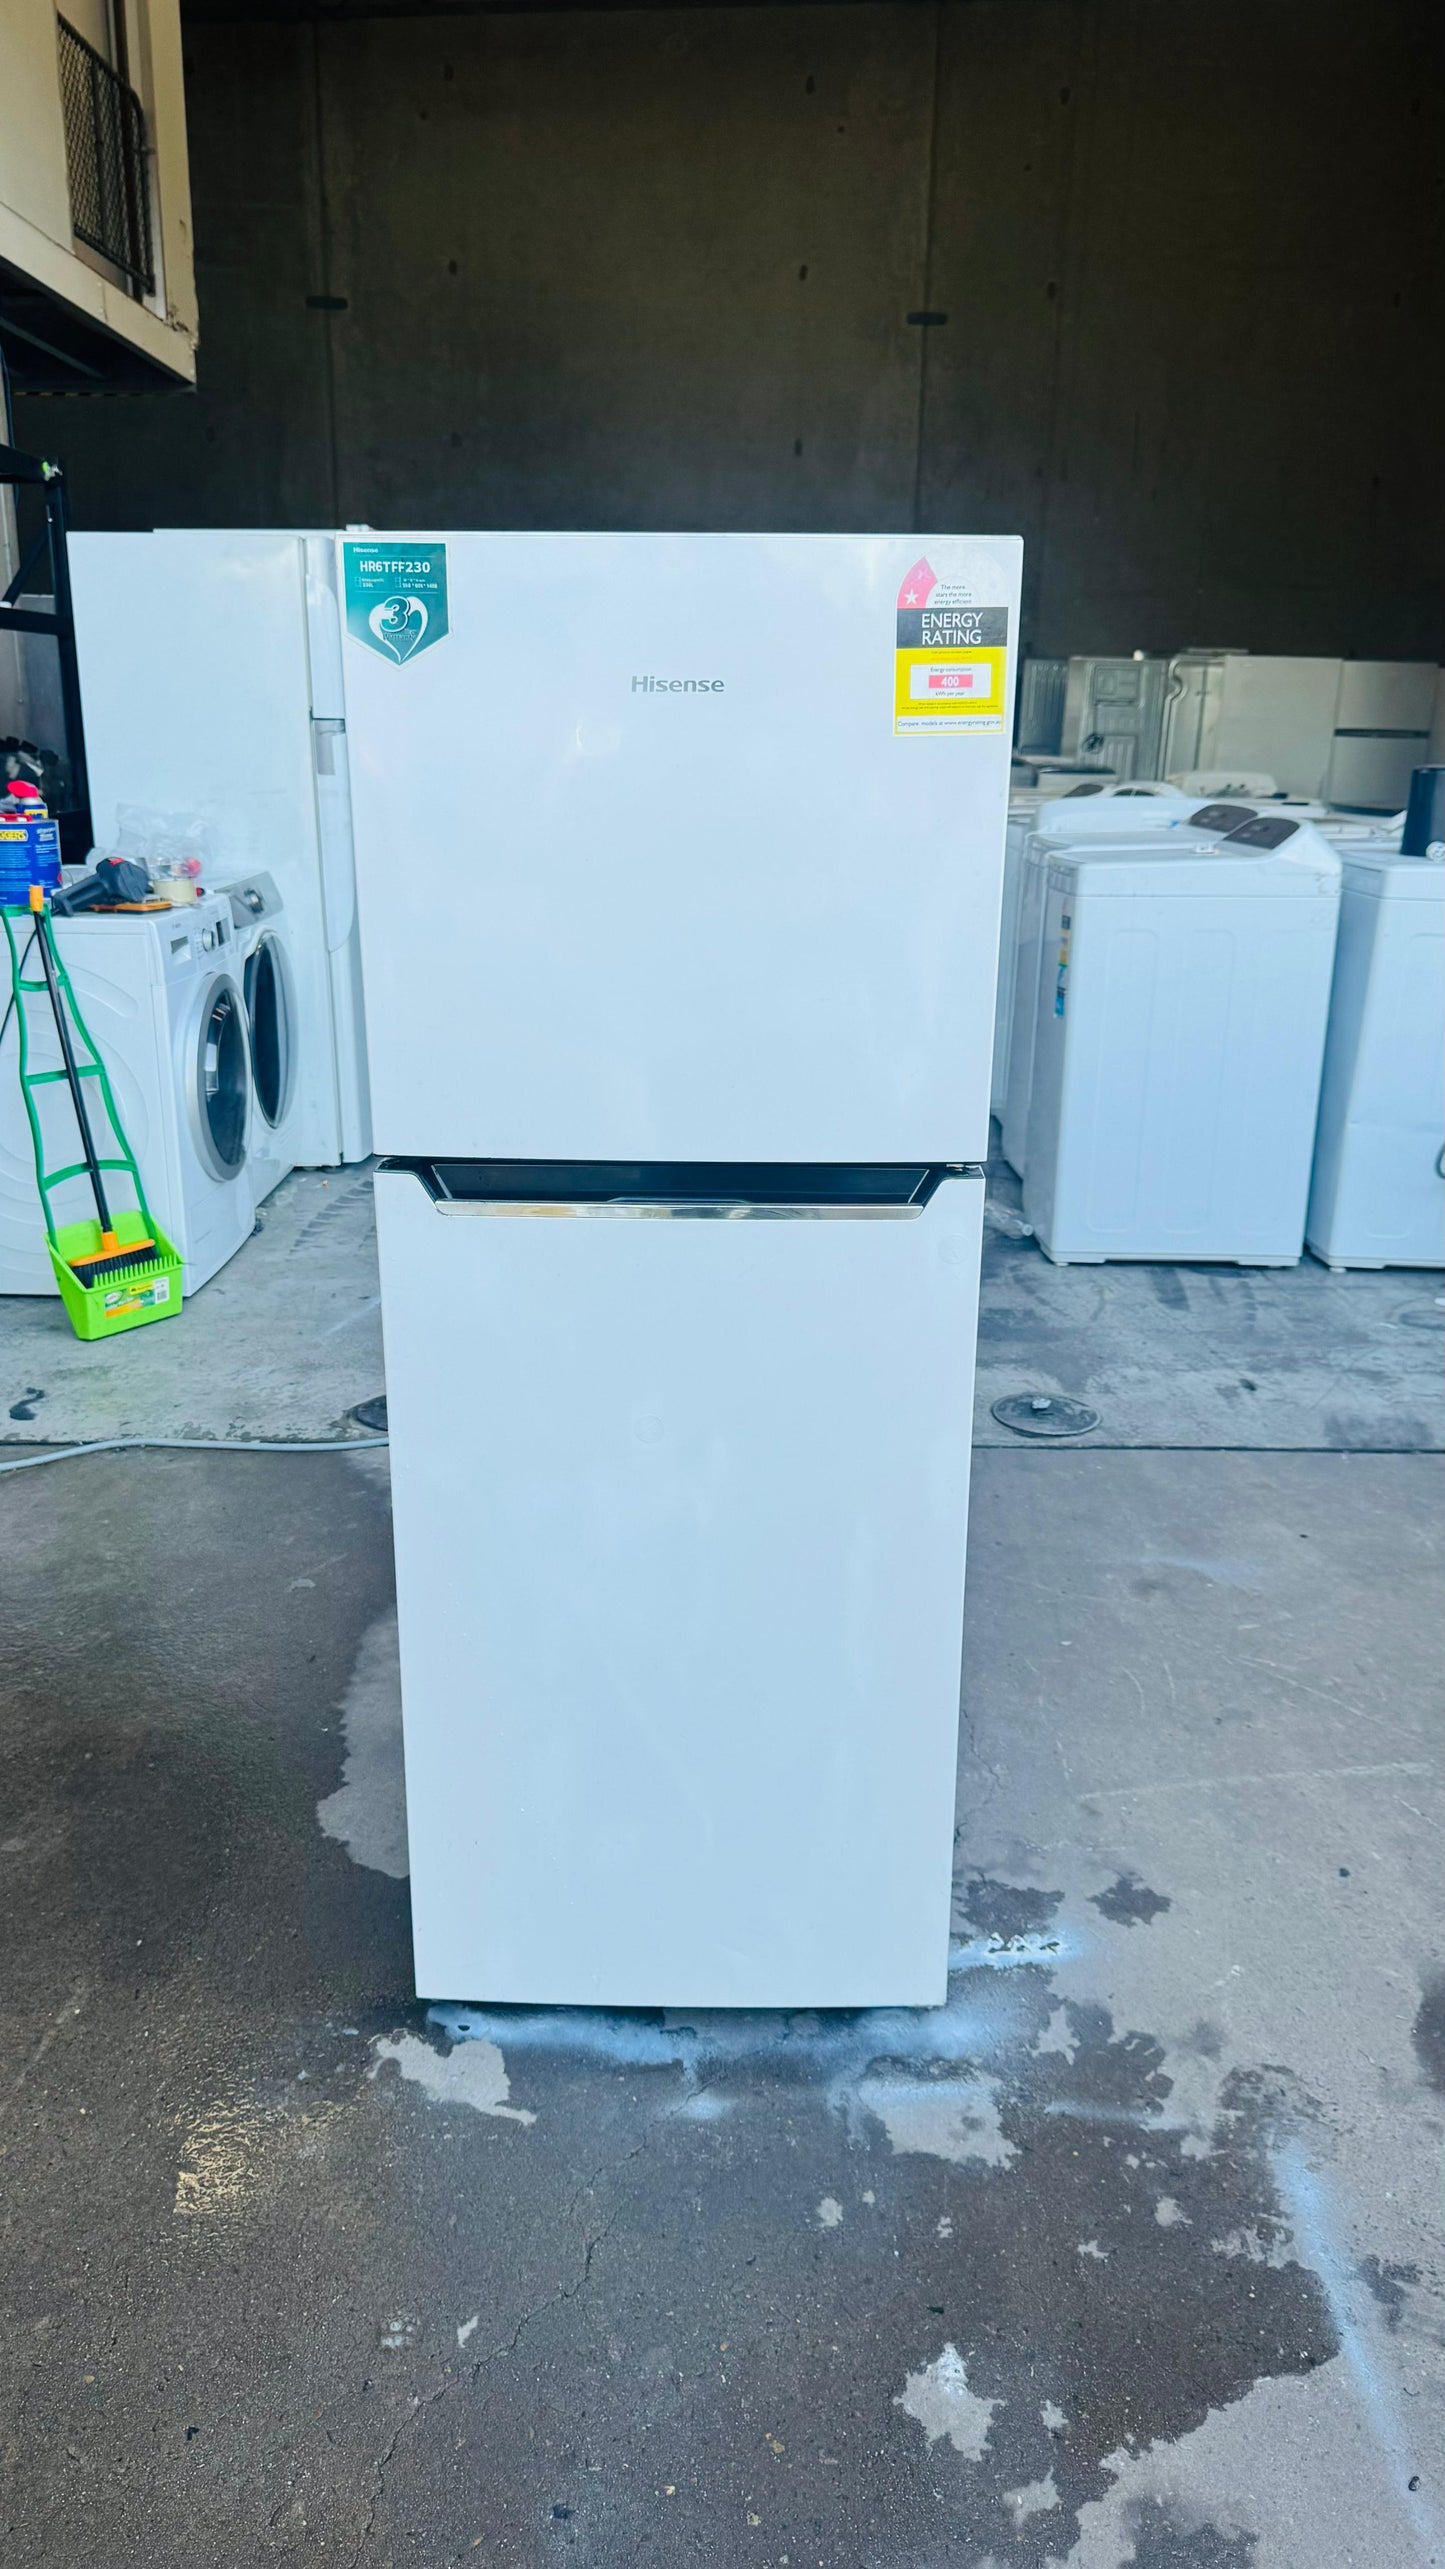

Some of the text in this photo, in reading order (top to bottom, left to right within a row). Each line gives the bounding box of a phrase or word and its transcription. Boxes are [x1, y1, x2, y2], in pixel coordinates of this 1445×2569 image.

[360, 561, 430, 573] HR6TFF230
[380, 595, 409, 632] 3
[921, 612, 984, 628] ENERGY
[922, 629, 982, 646] RATING
[631, 675, 725, 693] Hisense
[941, 676, 960, 687] 400
[897, 720, 919, 728] Compare
